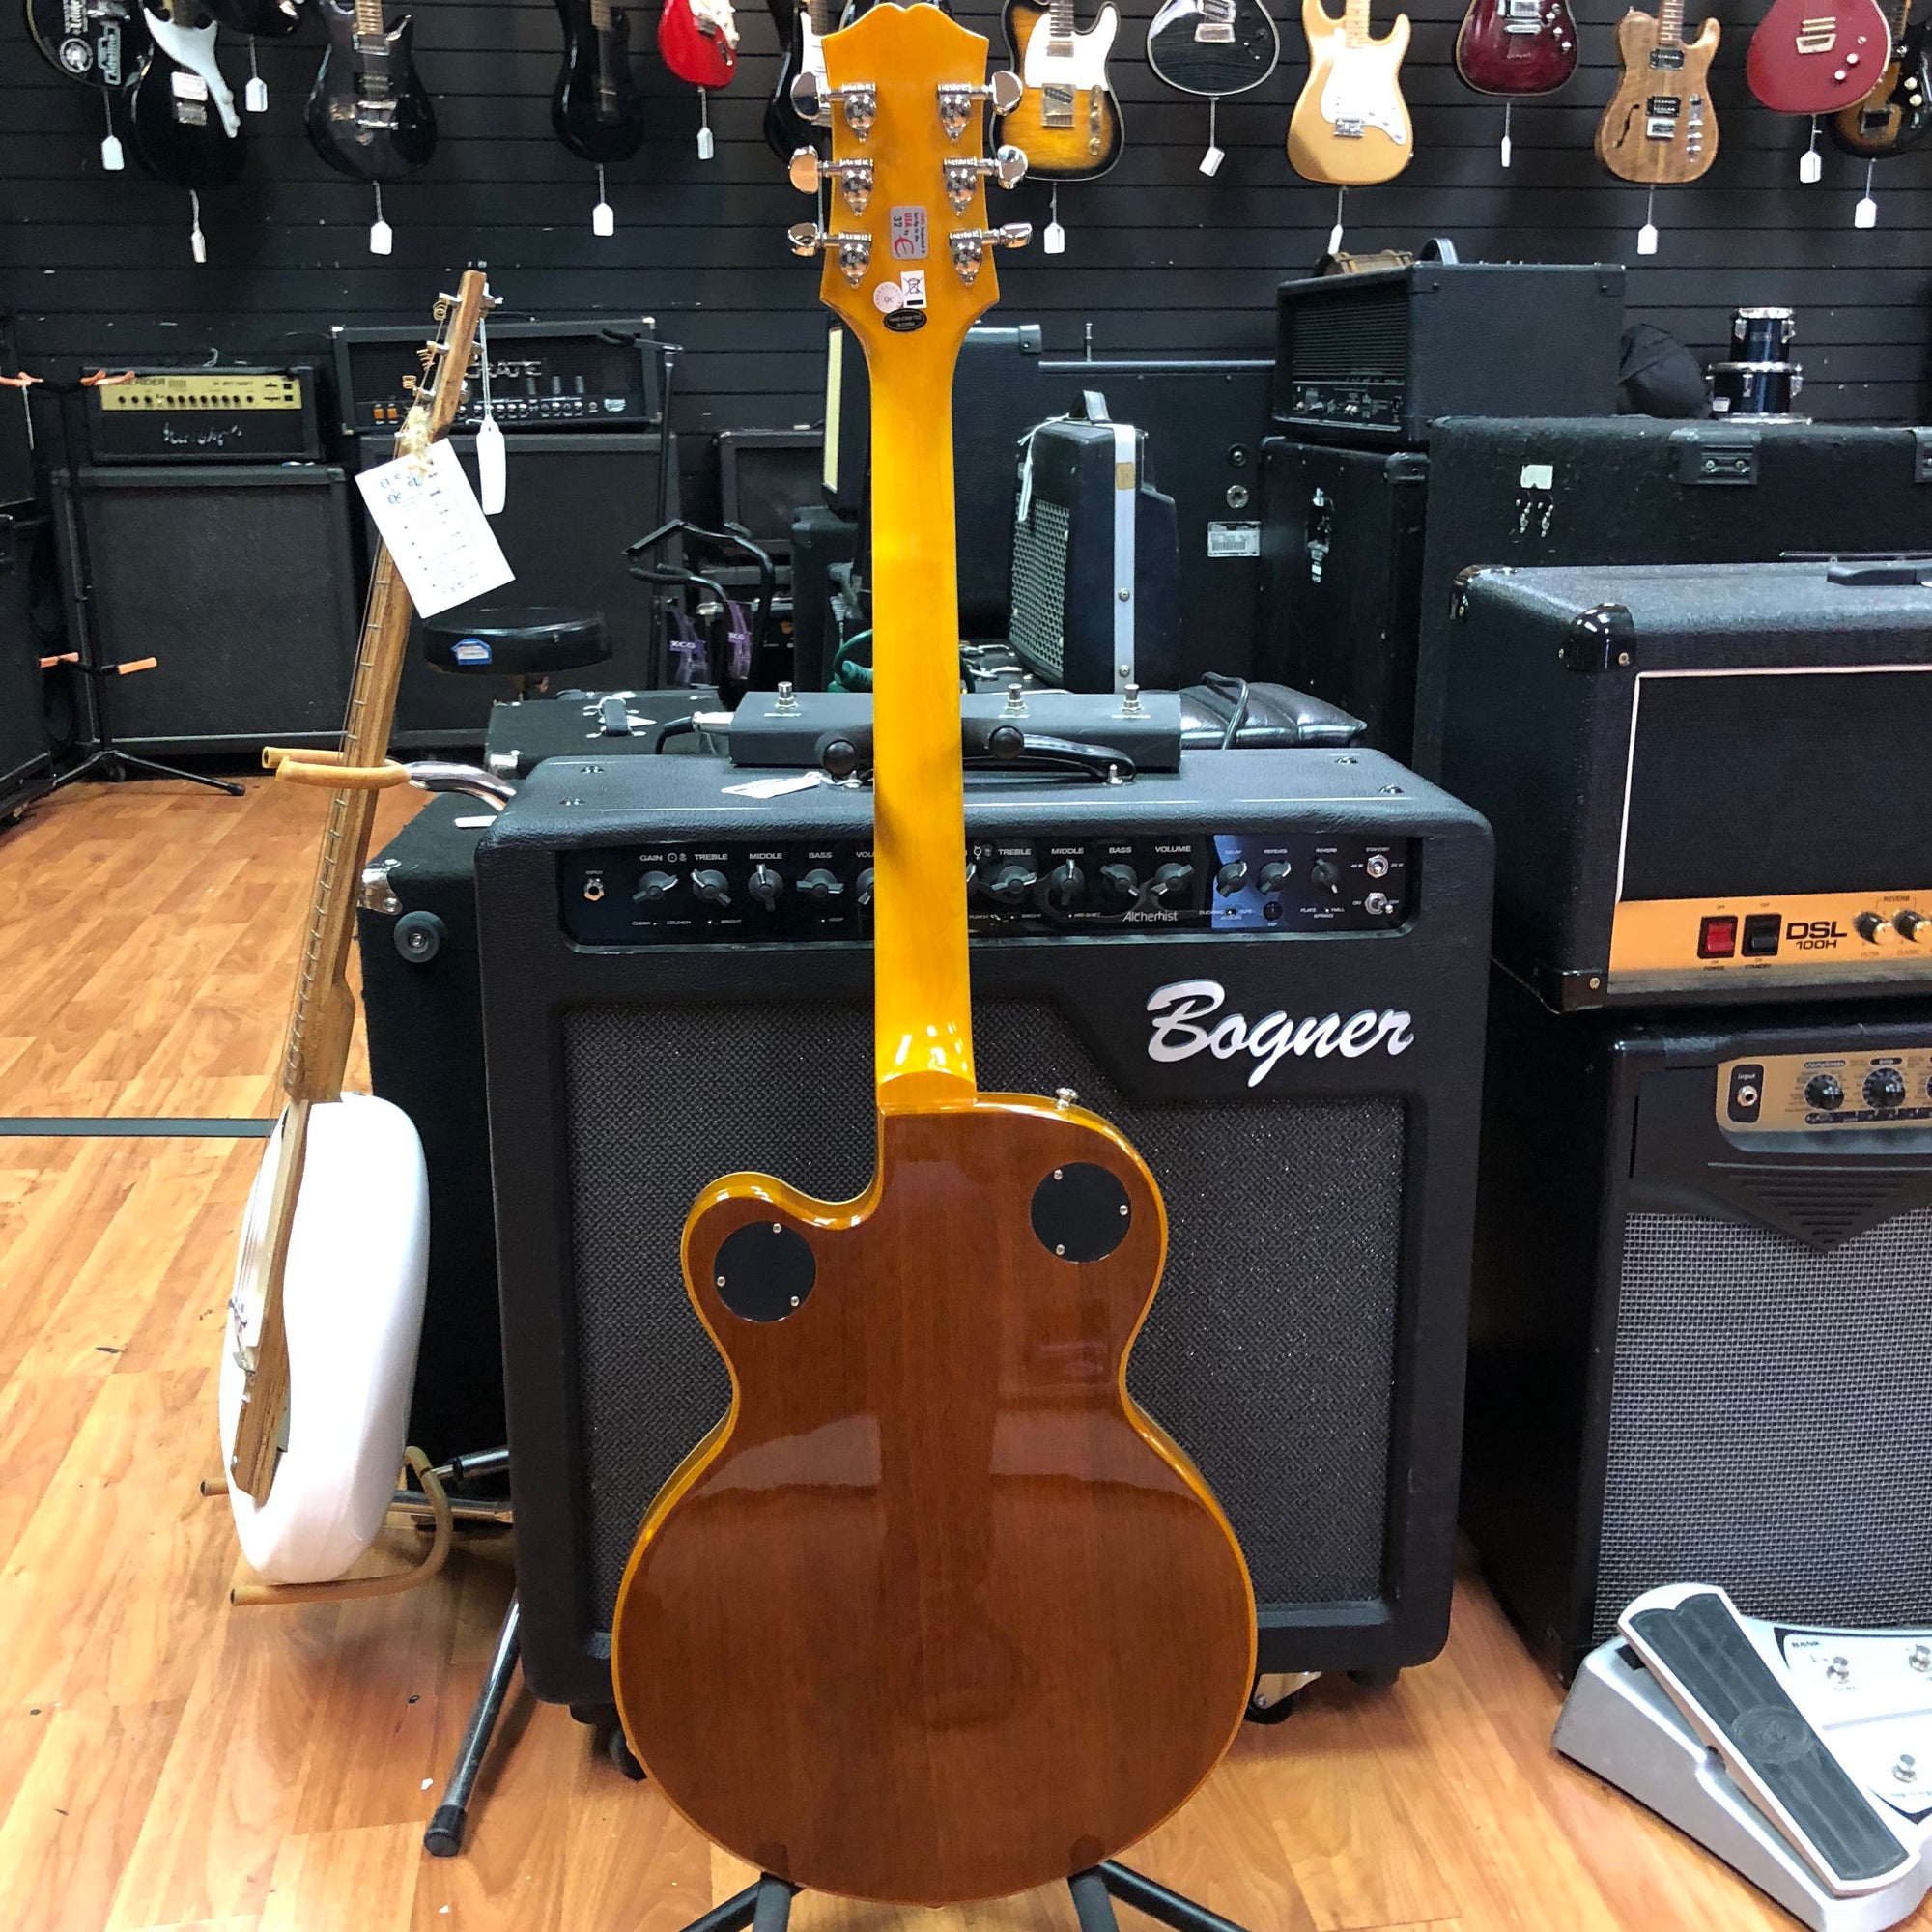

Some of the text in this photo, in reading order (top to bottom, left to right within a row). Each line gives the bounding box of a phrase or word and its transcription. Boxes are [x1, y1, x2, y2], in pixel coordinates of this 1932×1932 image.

[894, 215, 902, 228] 32
[1122, 910, 1179, 923] Alchemist
[1786, 921, 1847, 940] DSL
[1795, 939, 1837, 951] 100H
[1146, 978, 1414, 1087] Bogner
